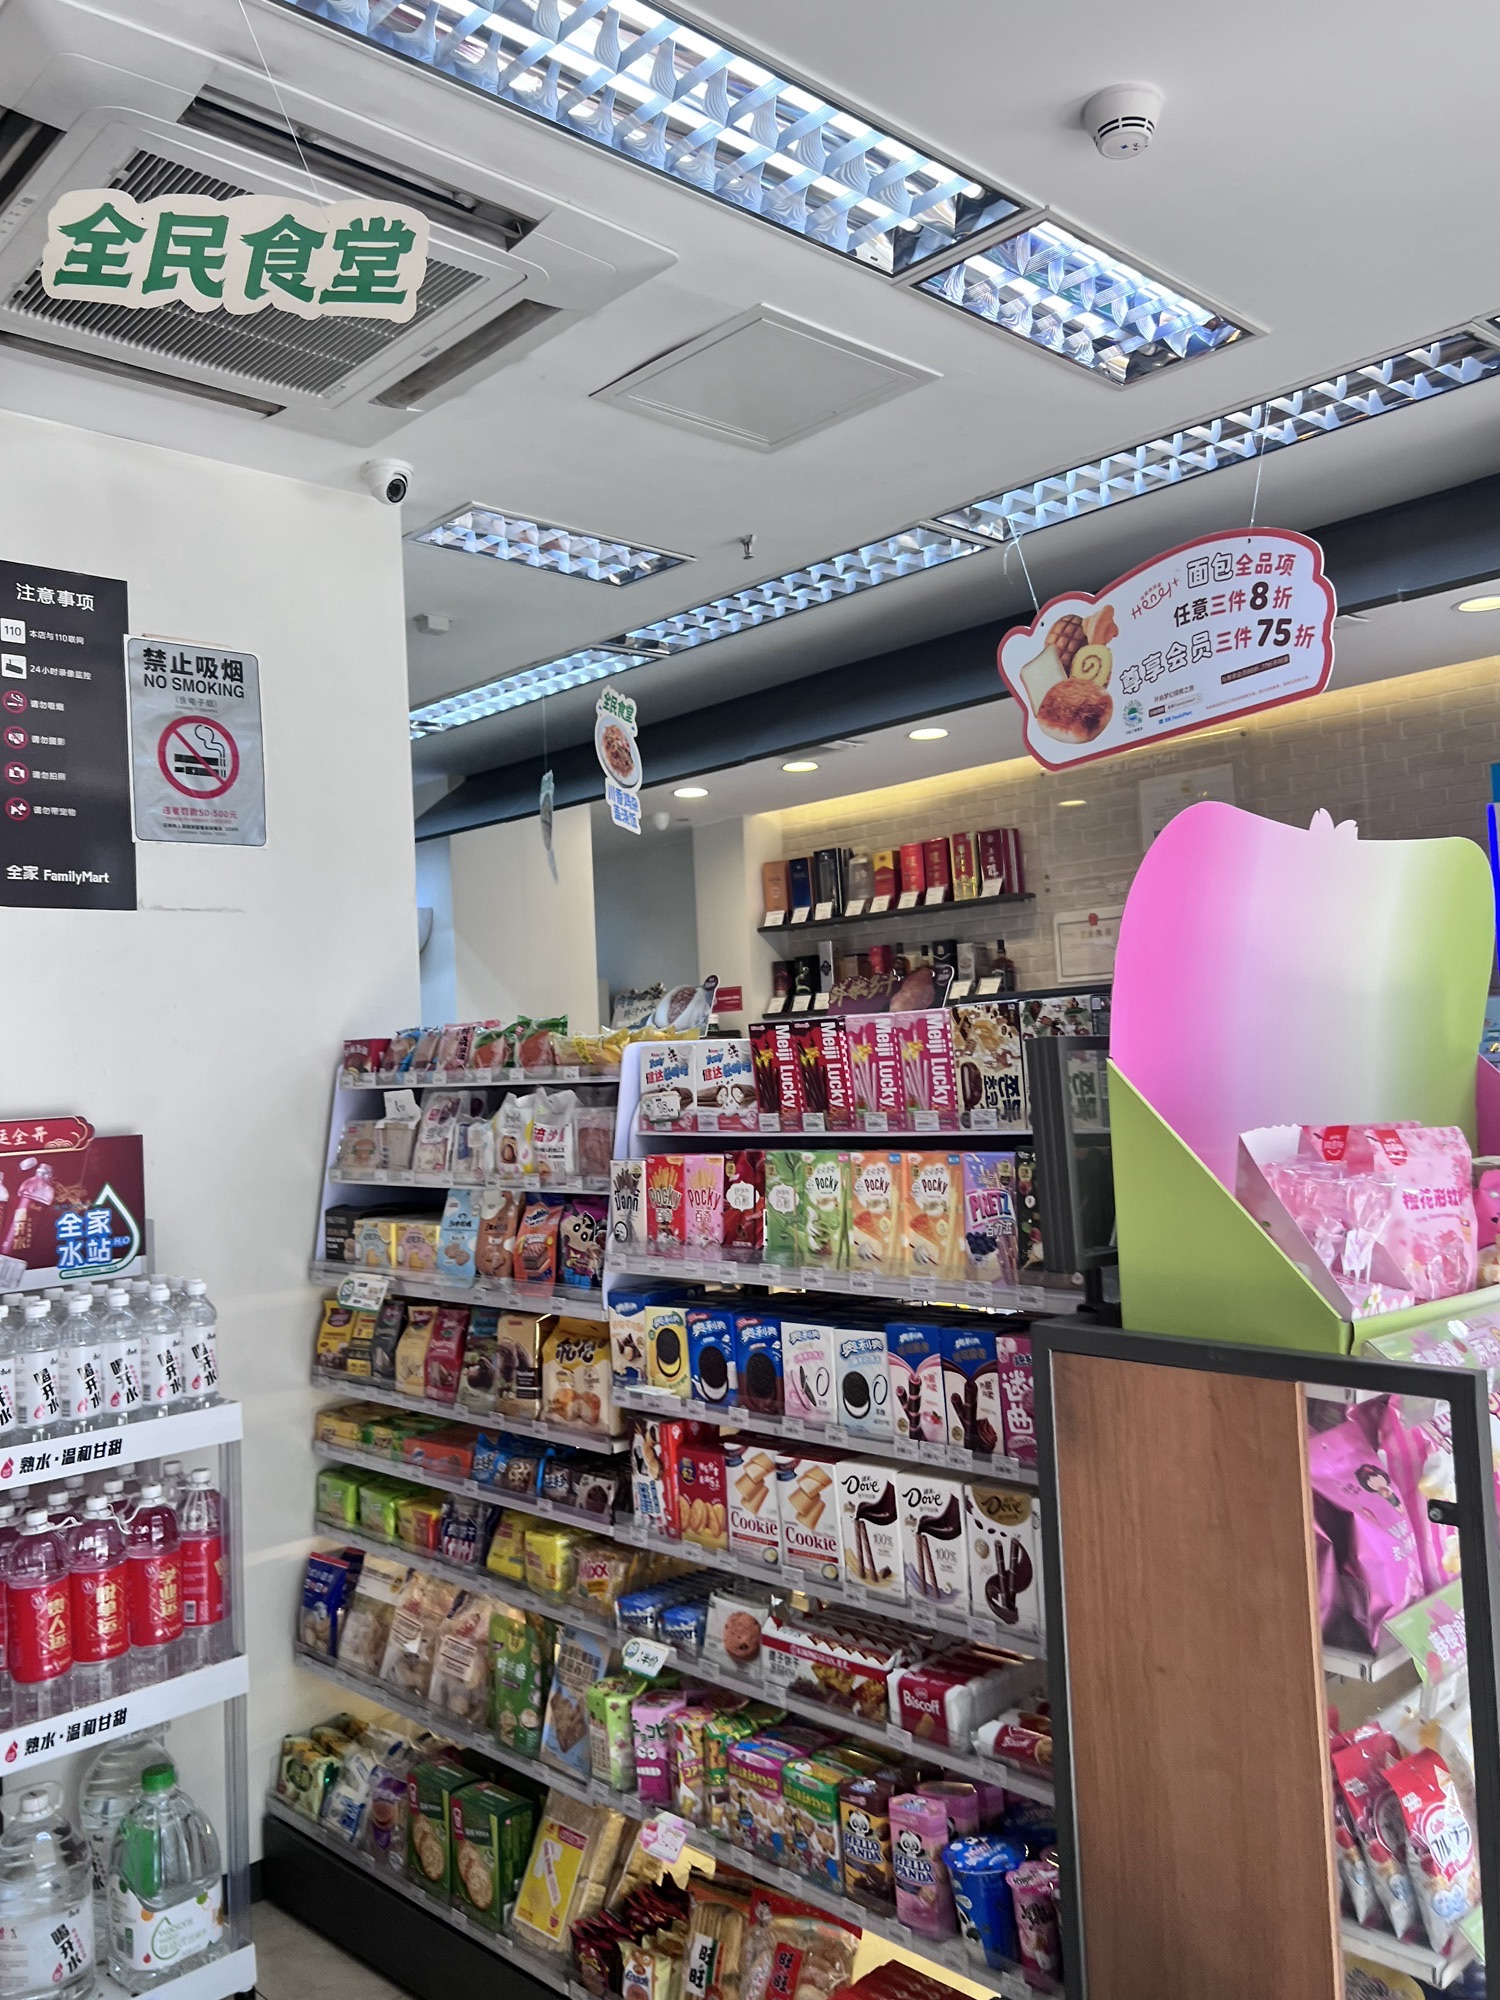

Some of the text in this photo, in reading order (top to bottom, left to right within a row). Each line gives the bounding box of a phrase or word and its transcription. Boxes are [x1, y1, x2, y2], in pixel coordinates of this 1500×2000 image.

[53, 202, 417, 305] 全民食堂
[1186, 552, 1297, 589] 面包全品项
[16, 583, 95, 611] 注意事项
[1174, 581, 1294, 627] 任意三件8折
[4, 625, 22, 637] 110
[29, 629, 85, 645] 本店与110联网
[143, 647, 245, 684] 禁止吸烟
[1119, 618, 1316, 695] 尊享会员三件75折
[30, 664, 92, 681] 24小时录像监控
[143, 673, 246, 699] NO SMOKING
[6, 865, 110, 885] 全家 FamilyMart
[774, 1024, 798, 1113] Meiji Lucky
[821, 1021, 845, 1110] Meiji Lucky
[874, 1017, 898, 1108] Meiji Lucky
[926, 1013, 951, 1106] Meiji Lucky
[57, 1208, 111, 1238] 全家
[58, 1237, 112, 1268] 水站
[19, 1437, 123, 1474] 熟水·温和甘甜
[841, 1475, 880, 1495] Dove
[902, 1487, 944, 1508] Dove
[981, 1495, 1024, 1515] Dove
[730, 1510, 778, 1536] Cookie
[785, 1524, 837, 1552] Cookie
[902, 1689, 940, 1716] Biscoff
[24, 1706, 128, 1756] 熟水·温和甘甜
[843, 1833, 880, 1851] HELLO
[843, 1846, 883, 1864] PANDA
[893, 1855, 933, 1873] HELLO
[894, 1866, 936, 1883] PANDA
